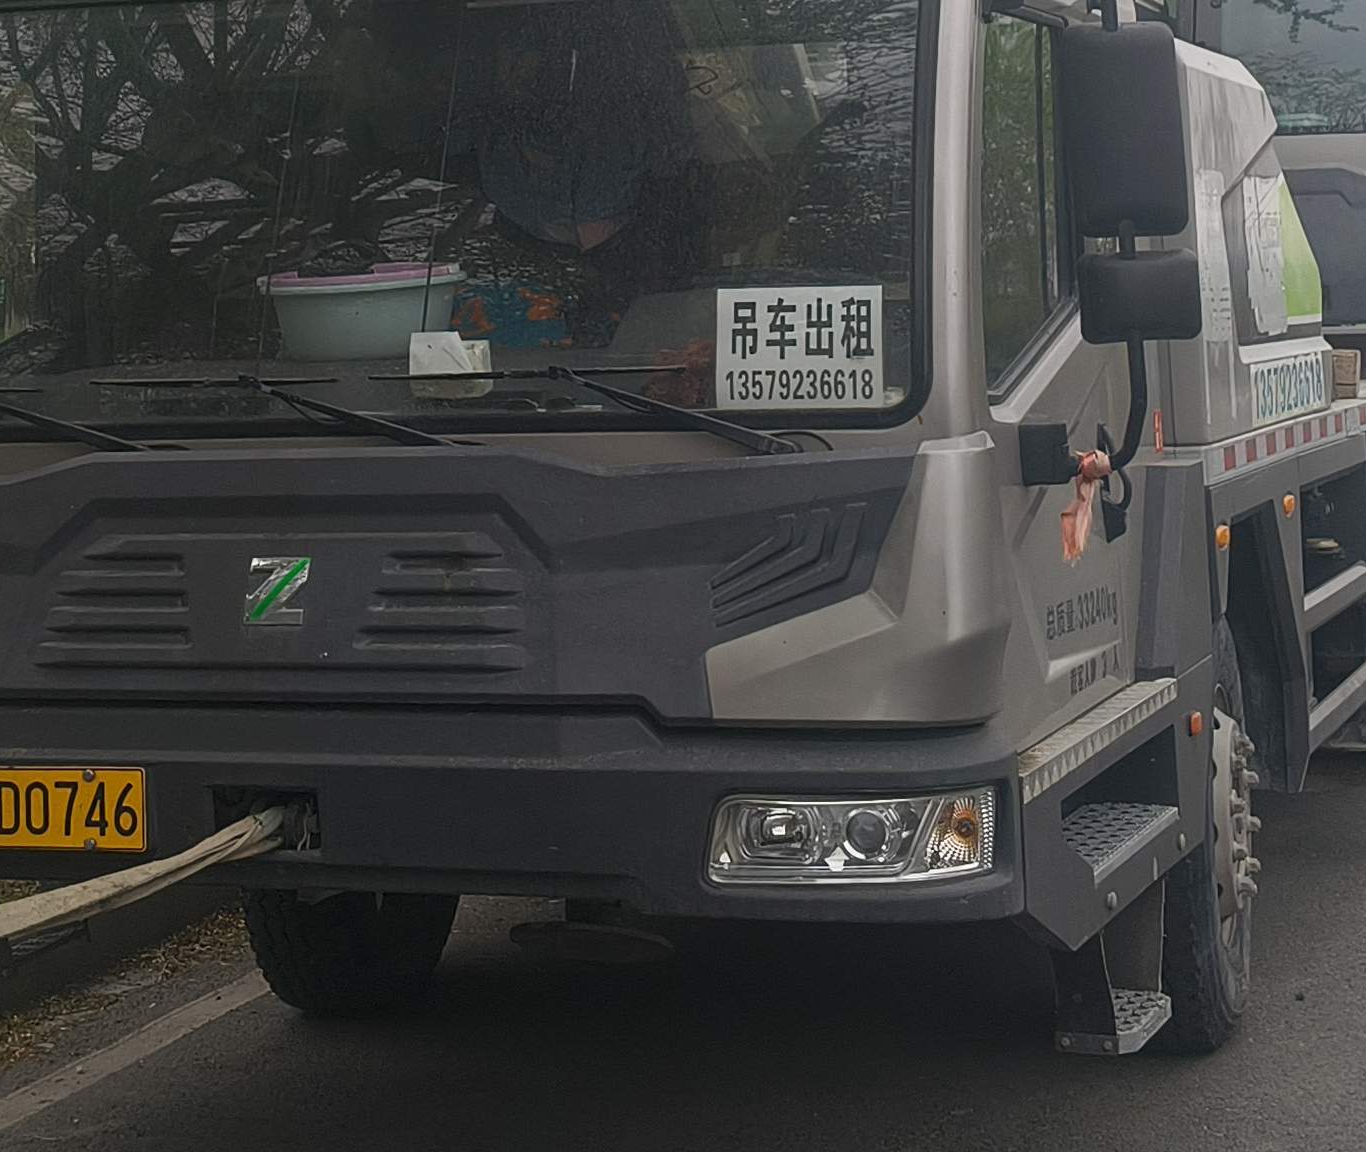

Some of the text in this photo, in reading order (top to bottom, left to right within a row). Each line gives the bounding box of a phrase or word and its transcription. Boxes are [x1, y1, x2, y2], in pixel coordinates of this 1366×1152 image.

[731, 297, 874, 360] 吊车出租
[725, 369, 874, 400] 13579236618
[1255, 357, 1323, 419] 13579236618
